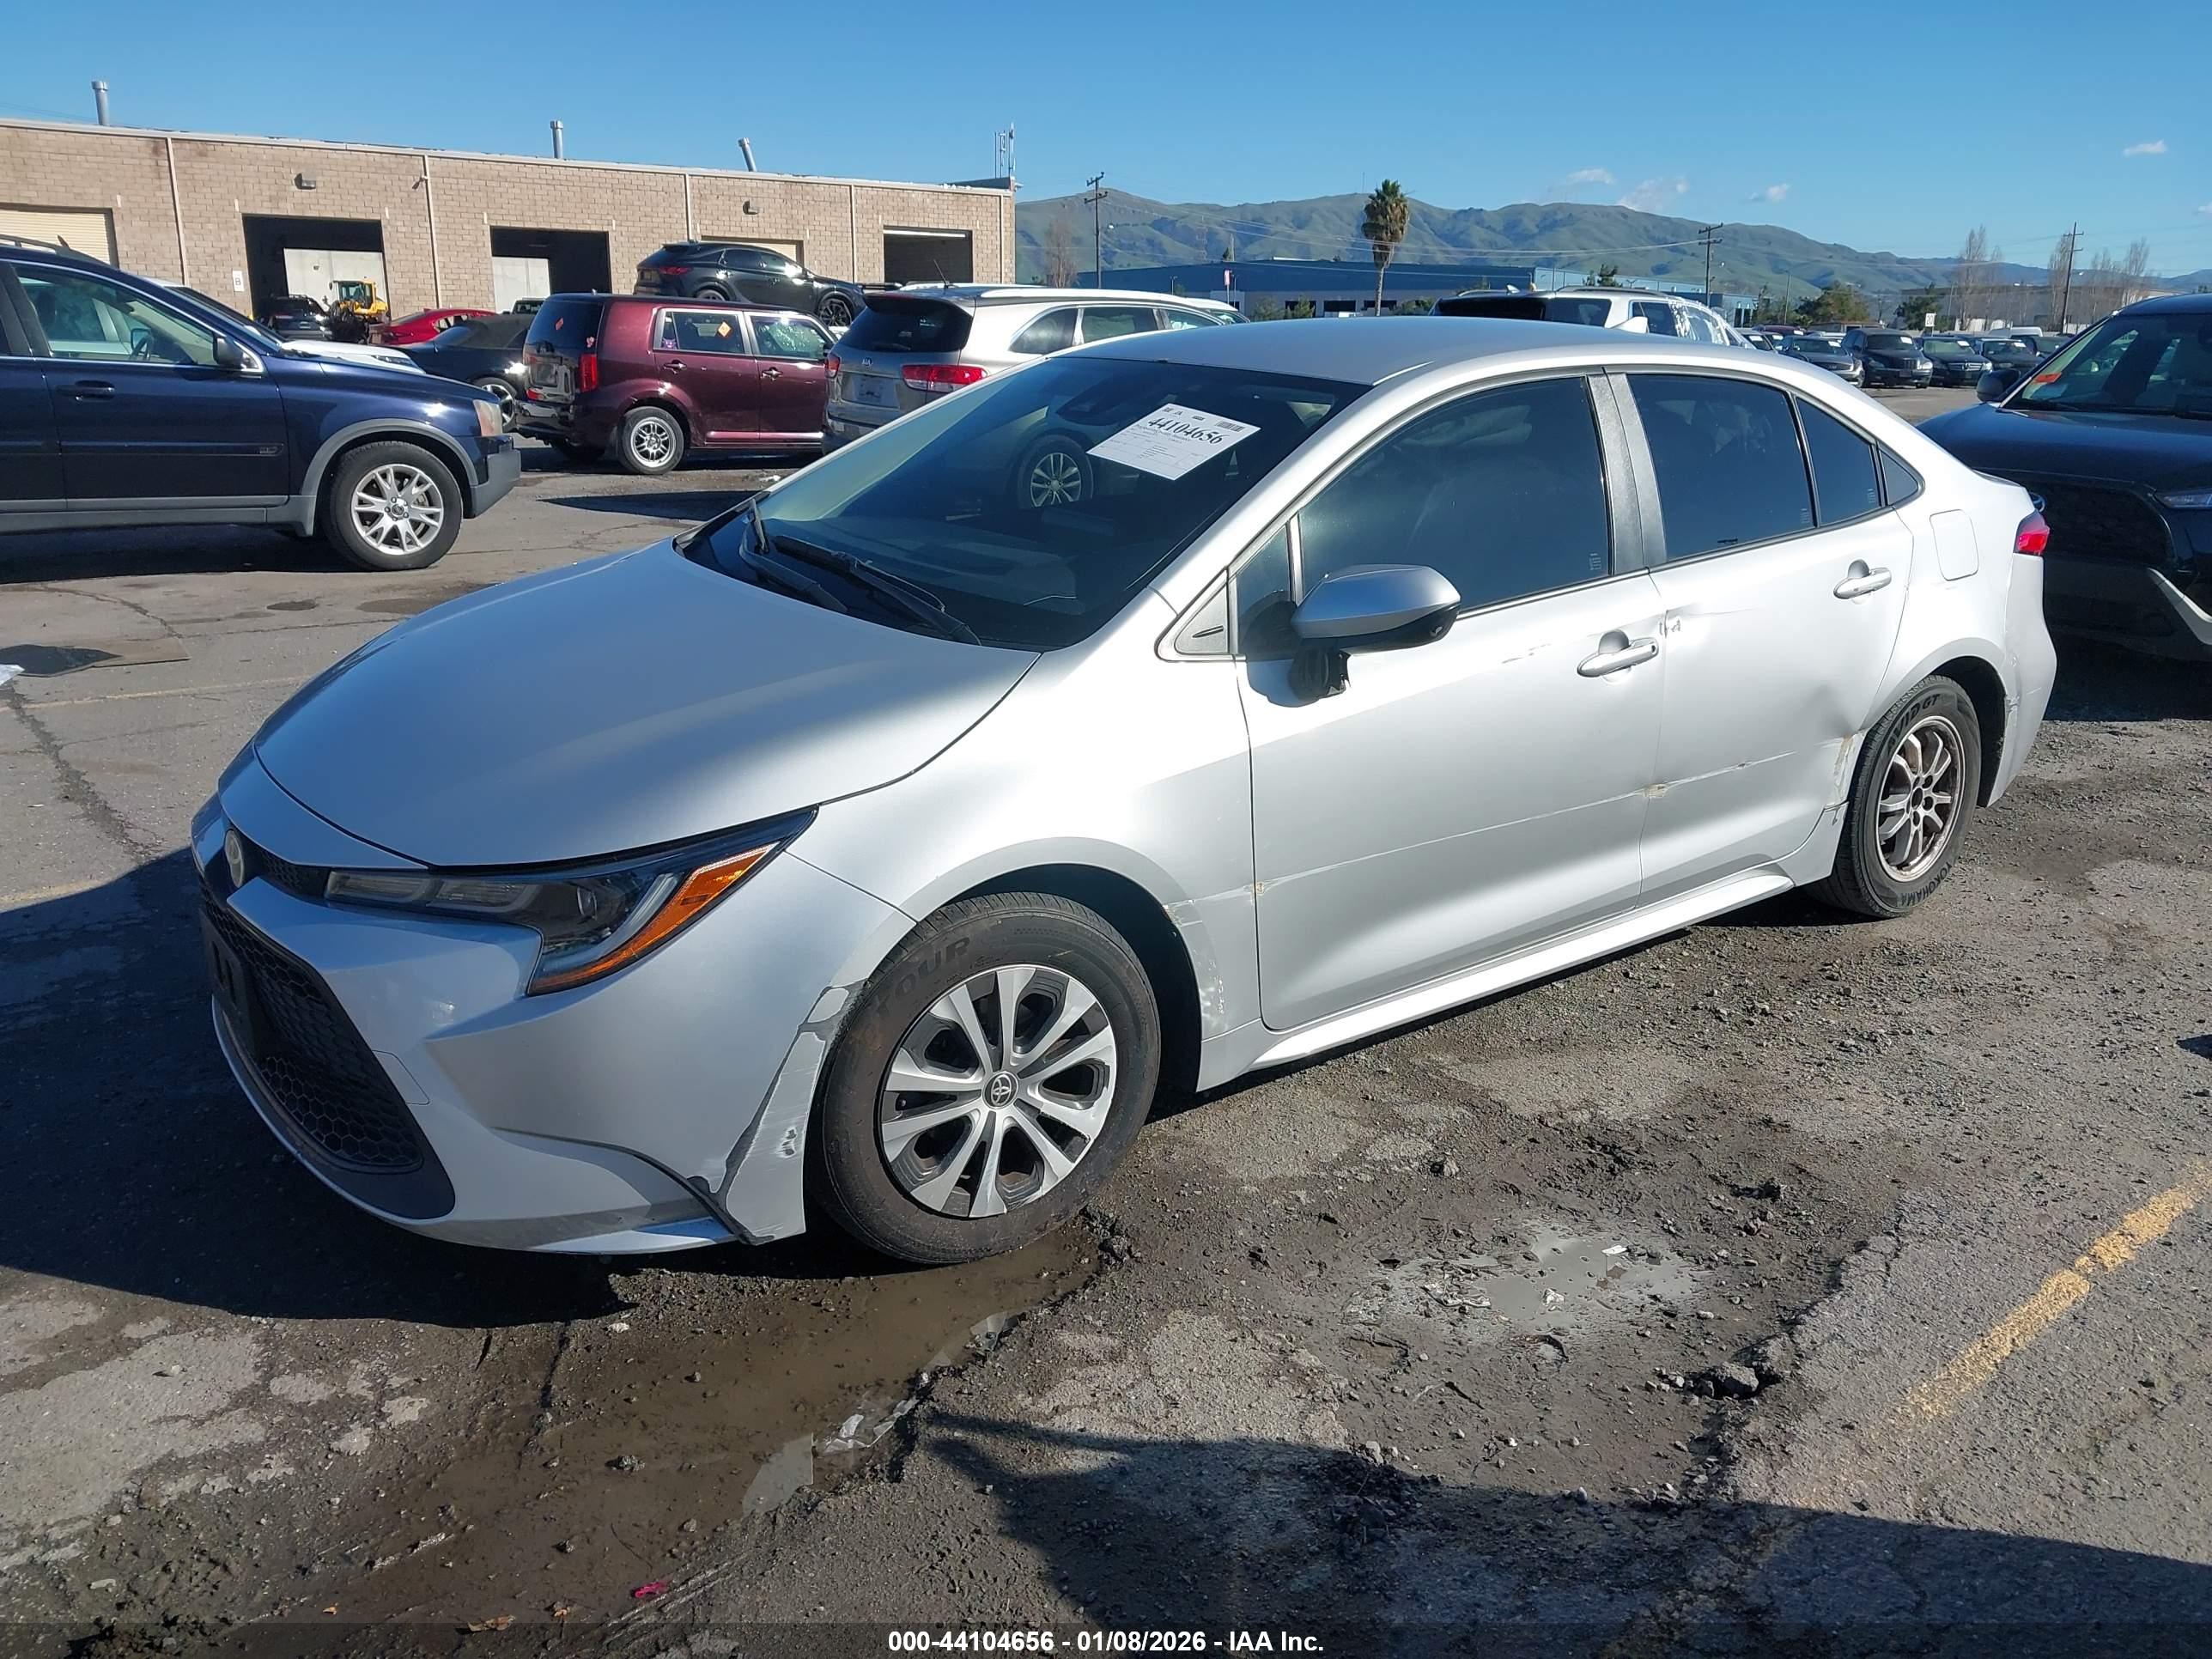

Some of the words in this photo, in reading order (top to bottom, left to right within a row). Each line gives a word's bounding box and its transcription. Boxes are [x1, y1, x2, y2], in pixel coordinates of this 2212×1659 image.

[234, 277, 241, 286] B
[1926, 314, 1934, 325] 20
[1147, 417, 1230, 445] 44104656
[1887, 702, 1920, 754] AVID
[1922, 693, 1941, 710] GT
[1899, 861, 1953, 907] YOKOHAMA
